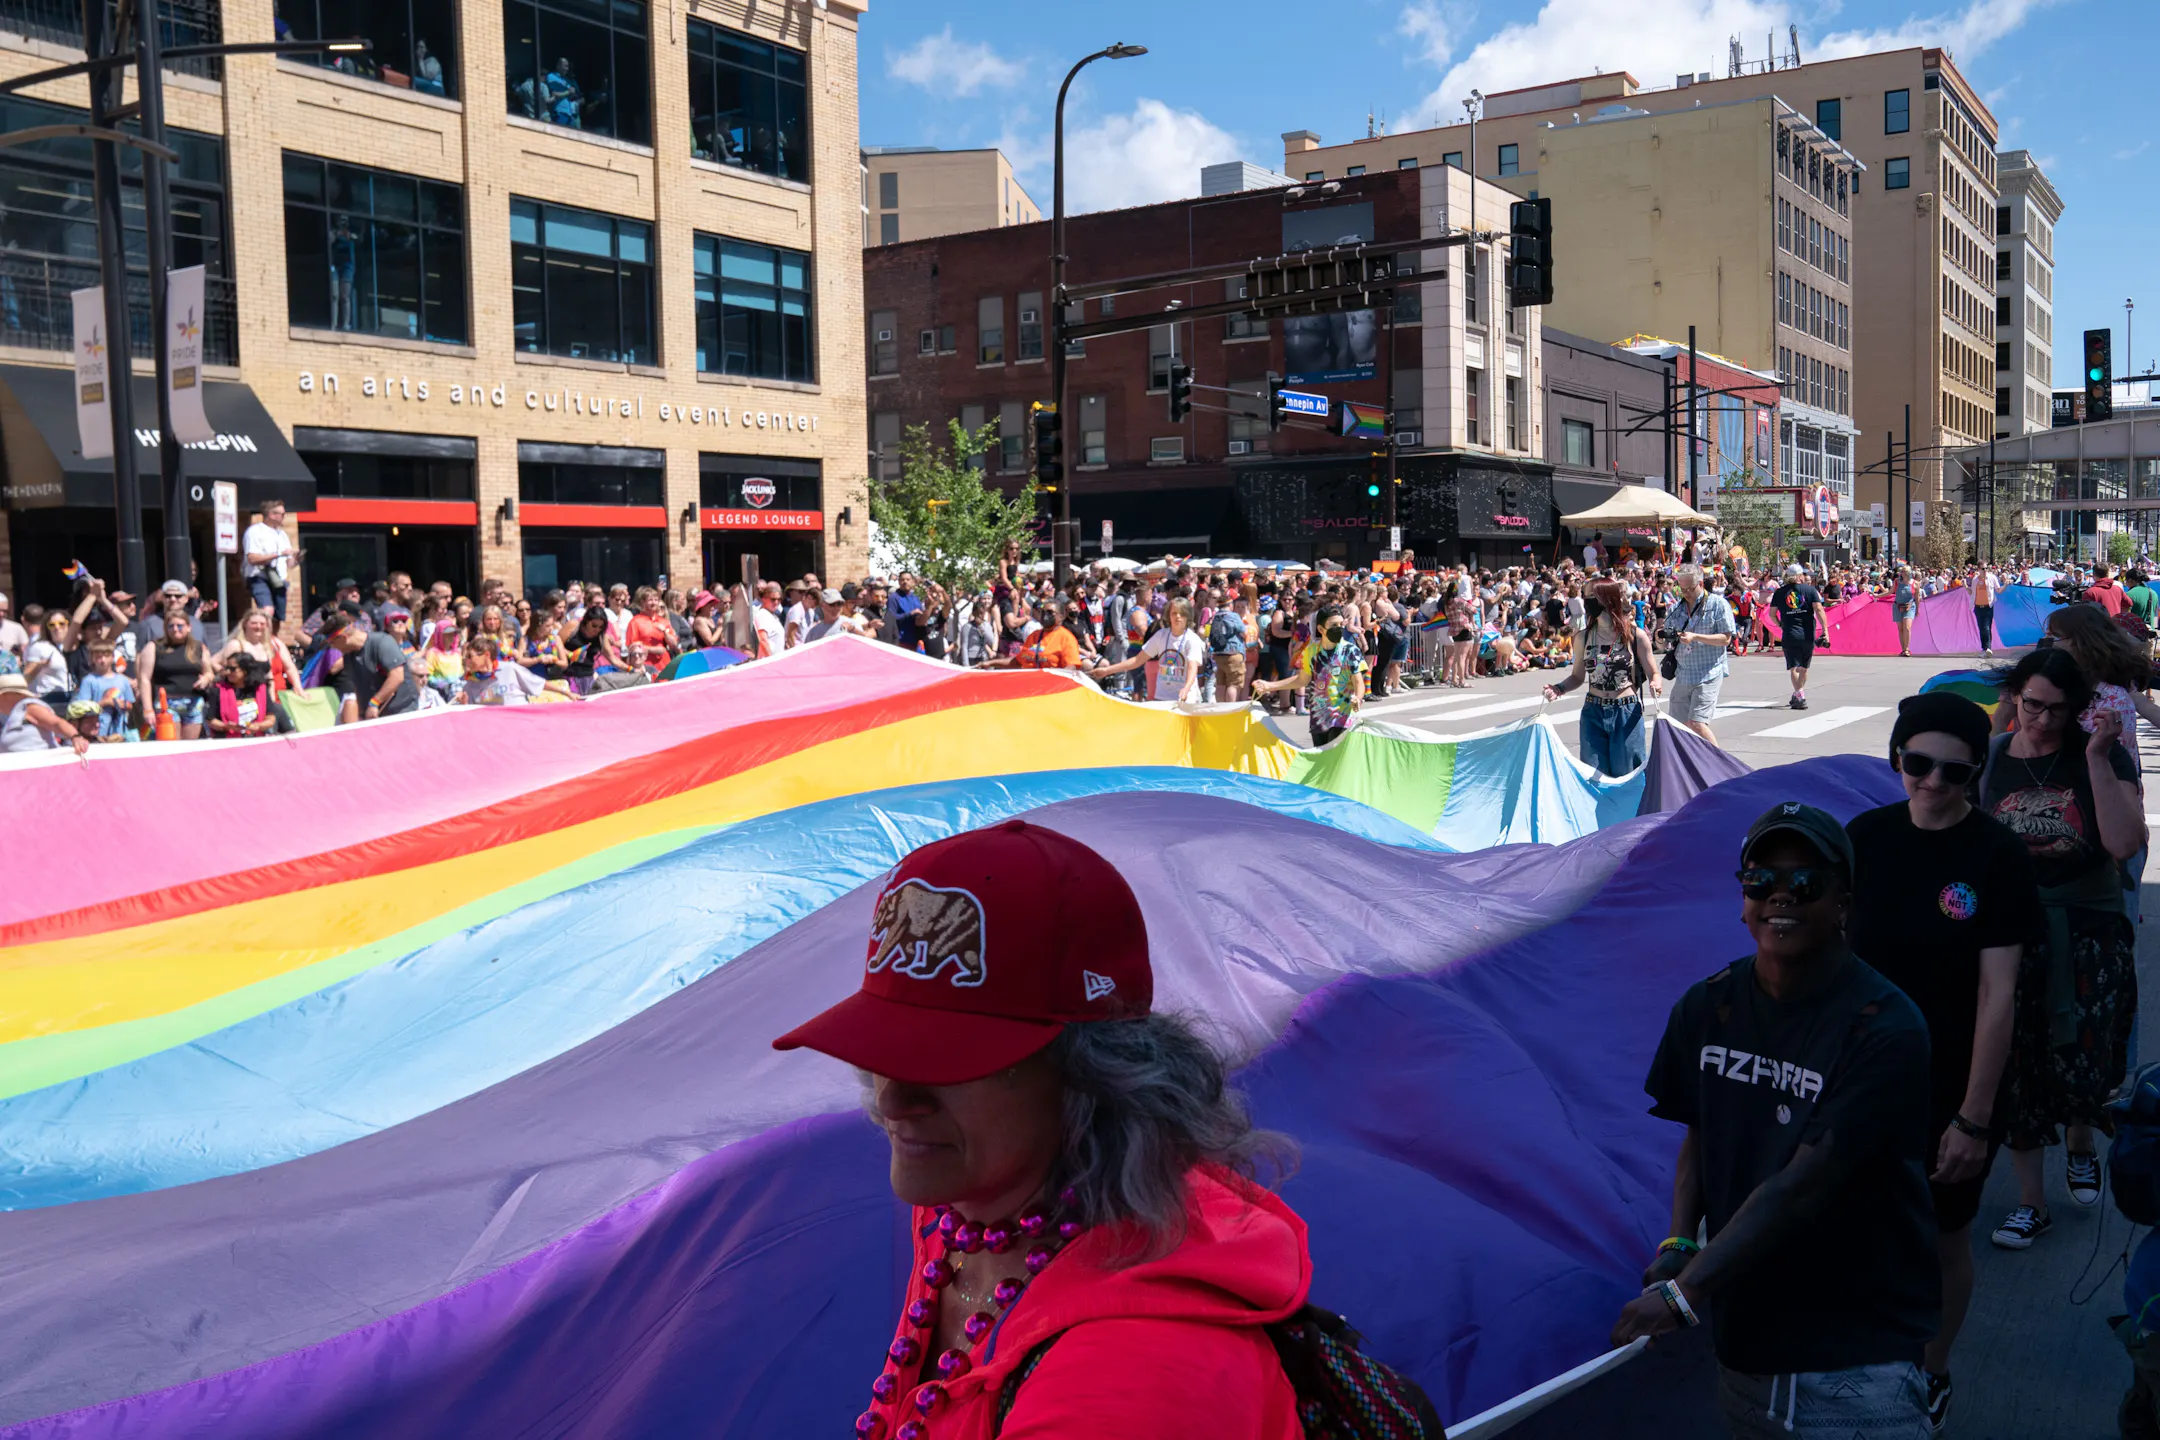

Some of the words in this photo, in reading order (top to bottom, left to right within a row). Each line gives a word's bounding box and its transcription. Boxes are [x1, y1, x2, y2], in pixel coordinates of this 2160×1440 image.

[171, 345, 197, 359] PRIDE
[299, 371, 339, 392] an
[363, 375, 430, 399] arts
[450, 382, 506, 406] and
[525, 389, 643, 418] cultural
[659, 403, 732, 425] event
[742, 410, 819, 431] center
[1279, 394, 1314, 411] ennepin
[711, 513, 758, 525] LEGEND
[765, 514, 811, 525] LOUNGE
[1500, 515, 1530, 526] SALOON
[1951, 890, 1967, 901] I'M
[1947, 898, 1968, 911] NOT
